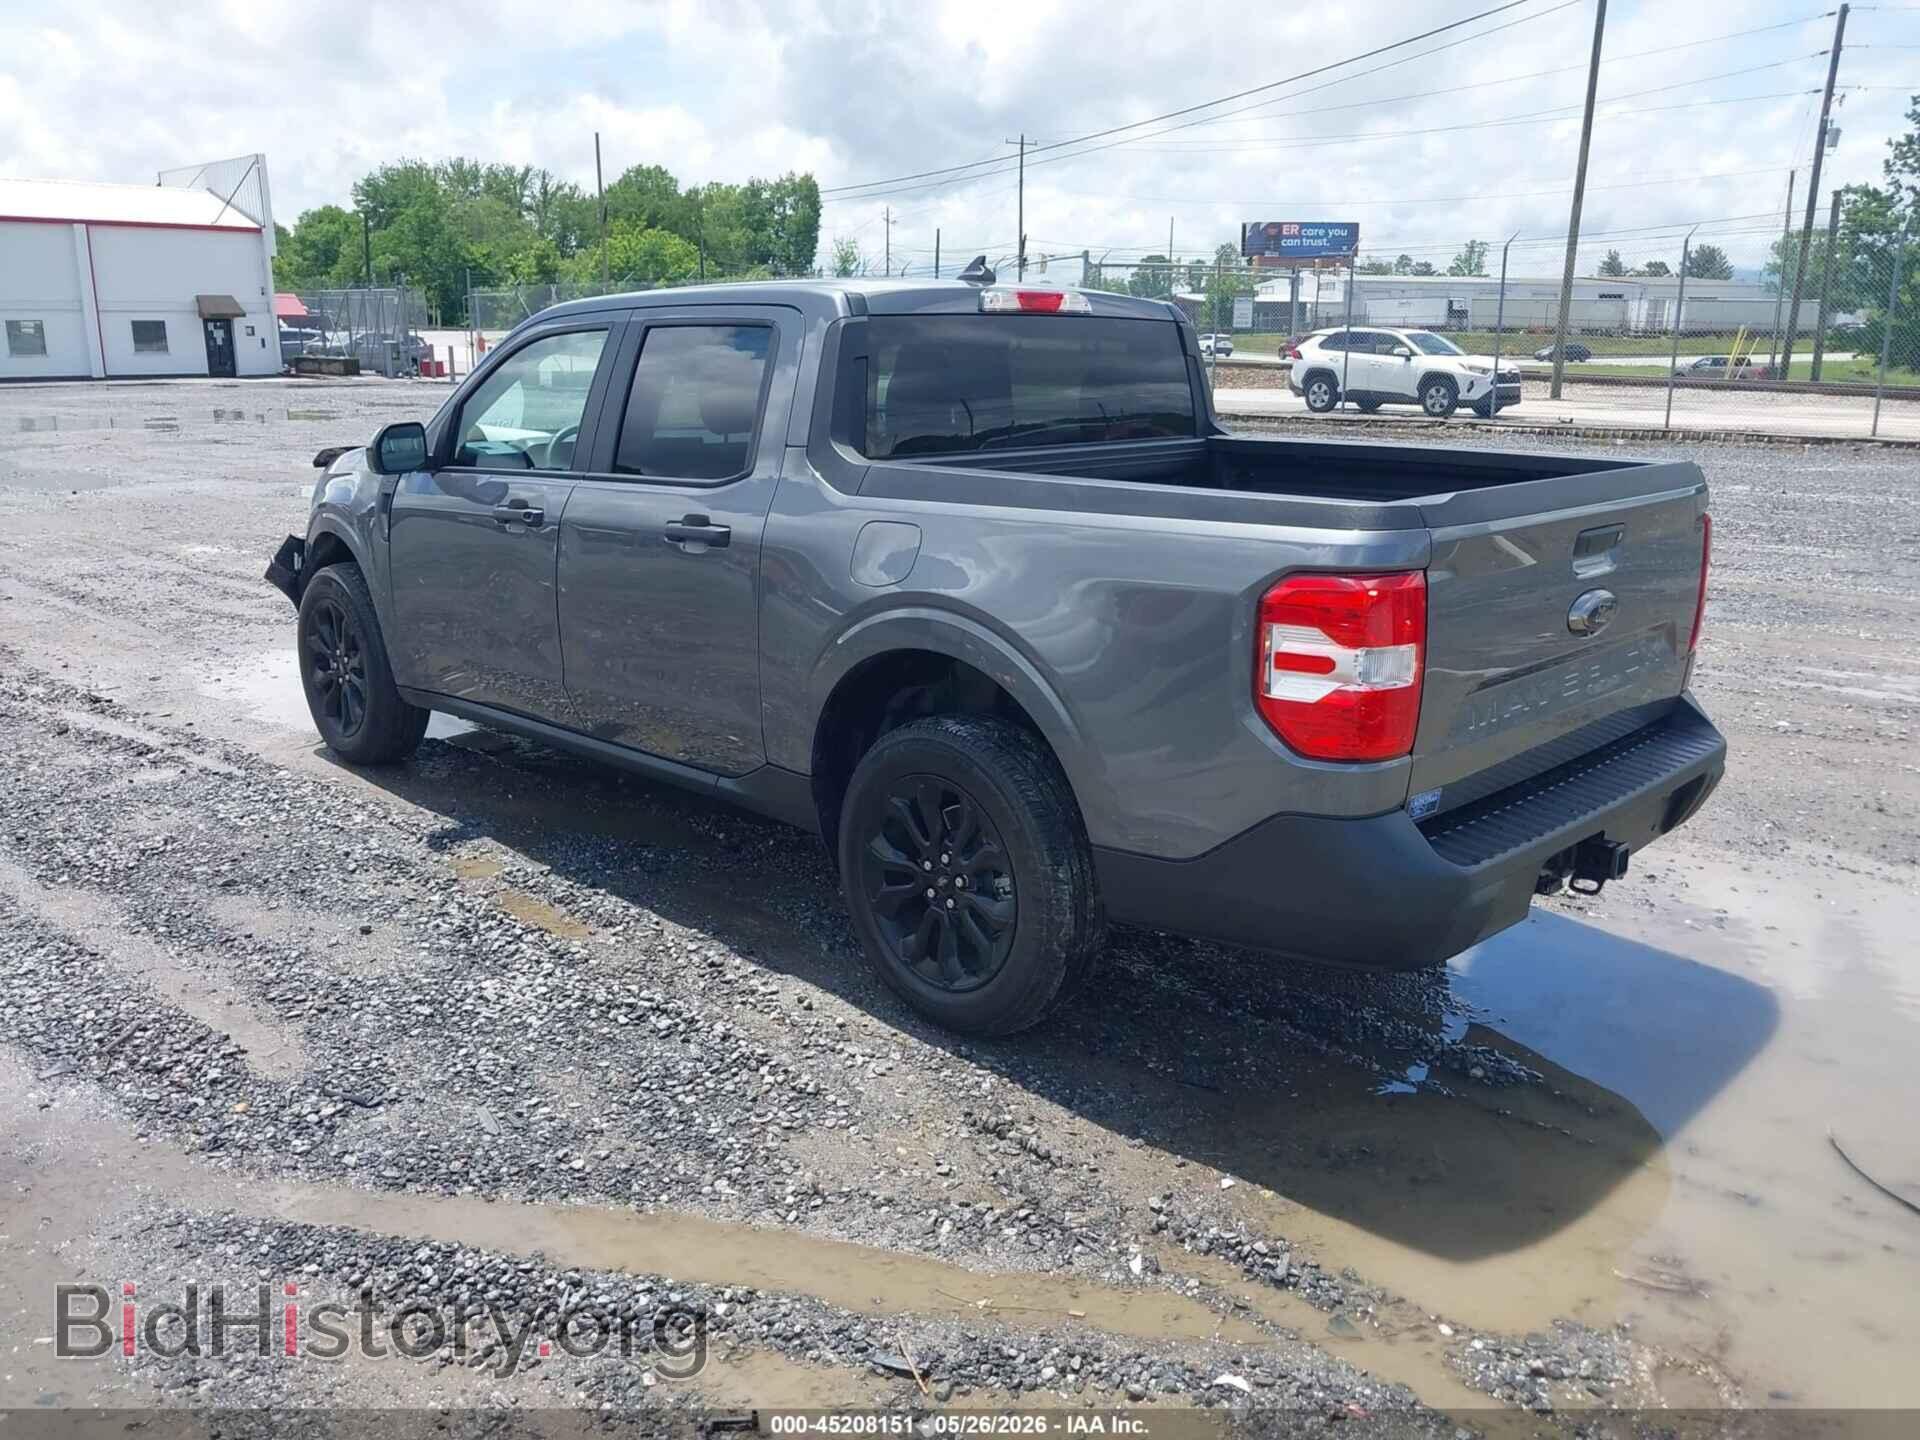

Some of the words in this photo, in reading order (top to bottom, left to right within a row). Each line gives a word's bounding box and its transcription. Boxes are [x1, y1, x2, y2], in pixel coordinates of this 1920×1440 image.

[1281, 224, 1300, 236] ER
[1301, 228, 1326, 236] care
[1328, 228, 1348, 238] you
[1281, 238, 1301, 247] can
[1302, 237, 1330, 247] trust.
